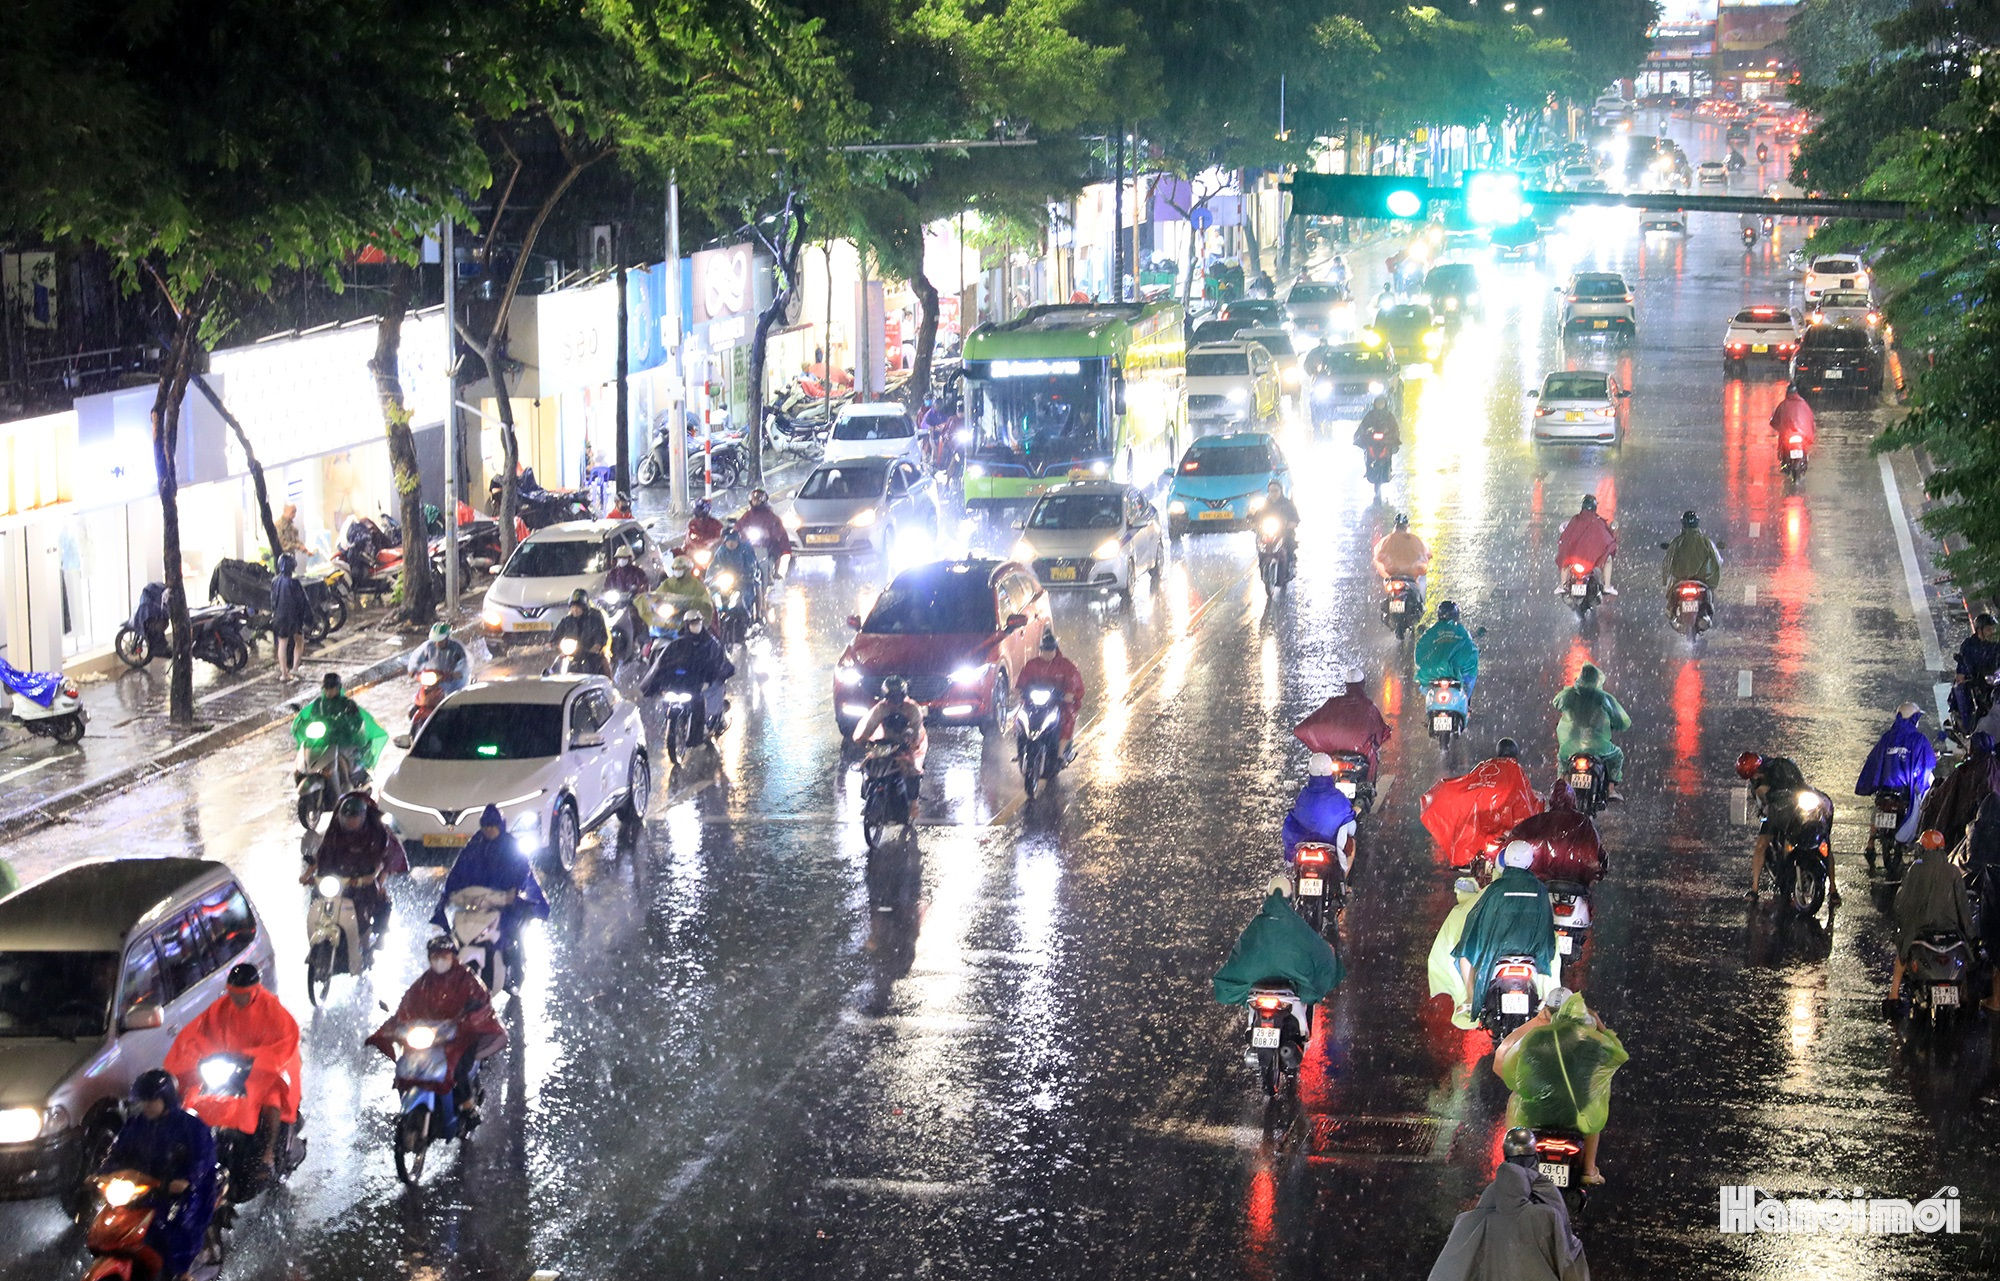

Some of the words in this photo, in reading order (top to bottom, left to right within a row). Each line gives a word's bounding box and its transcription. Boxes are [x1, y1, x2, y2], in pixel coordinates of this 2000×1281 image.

[1256, 1028, 1276, 1037] 29-BF
[1253, 1037, 1278, 1046] 008.70
[1542, 1164, 1565, 1175] 29-C1
